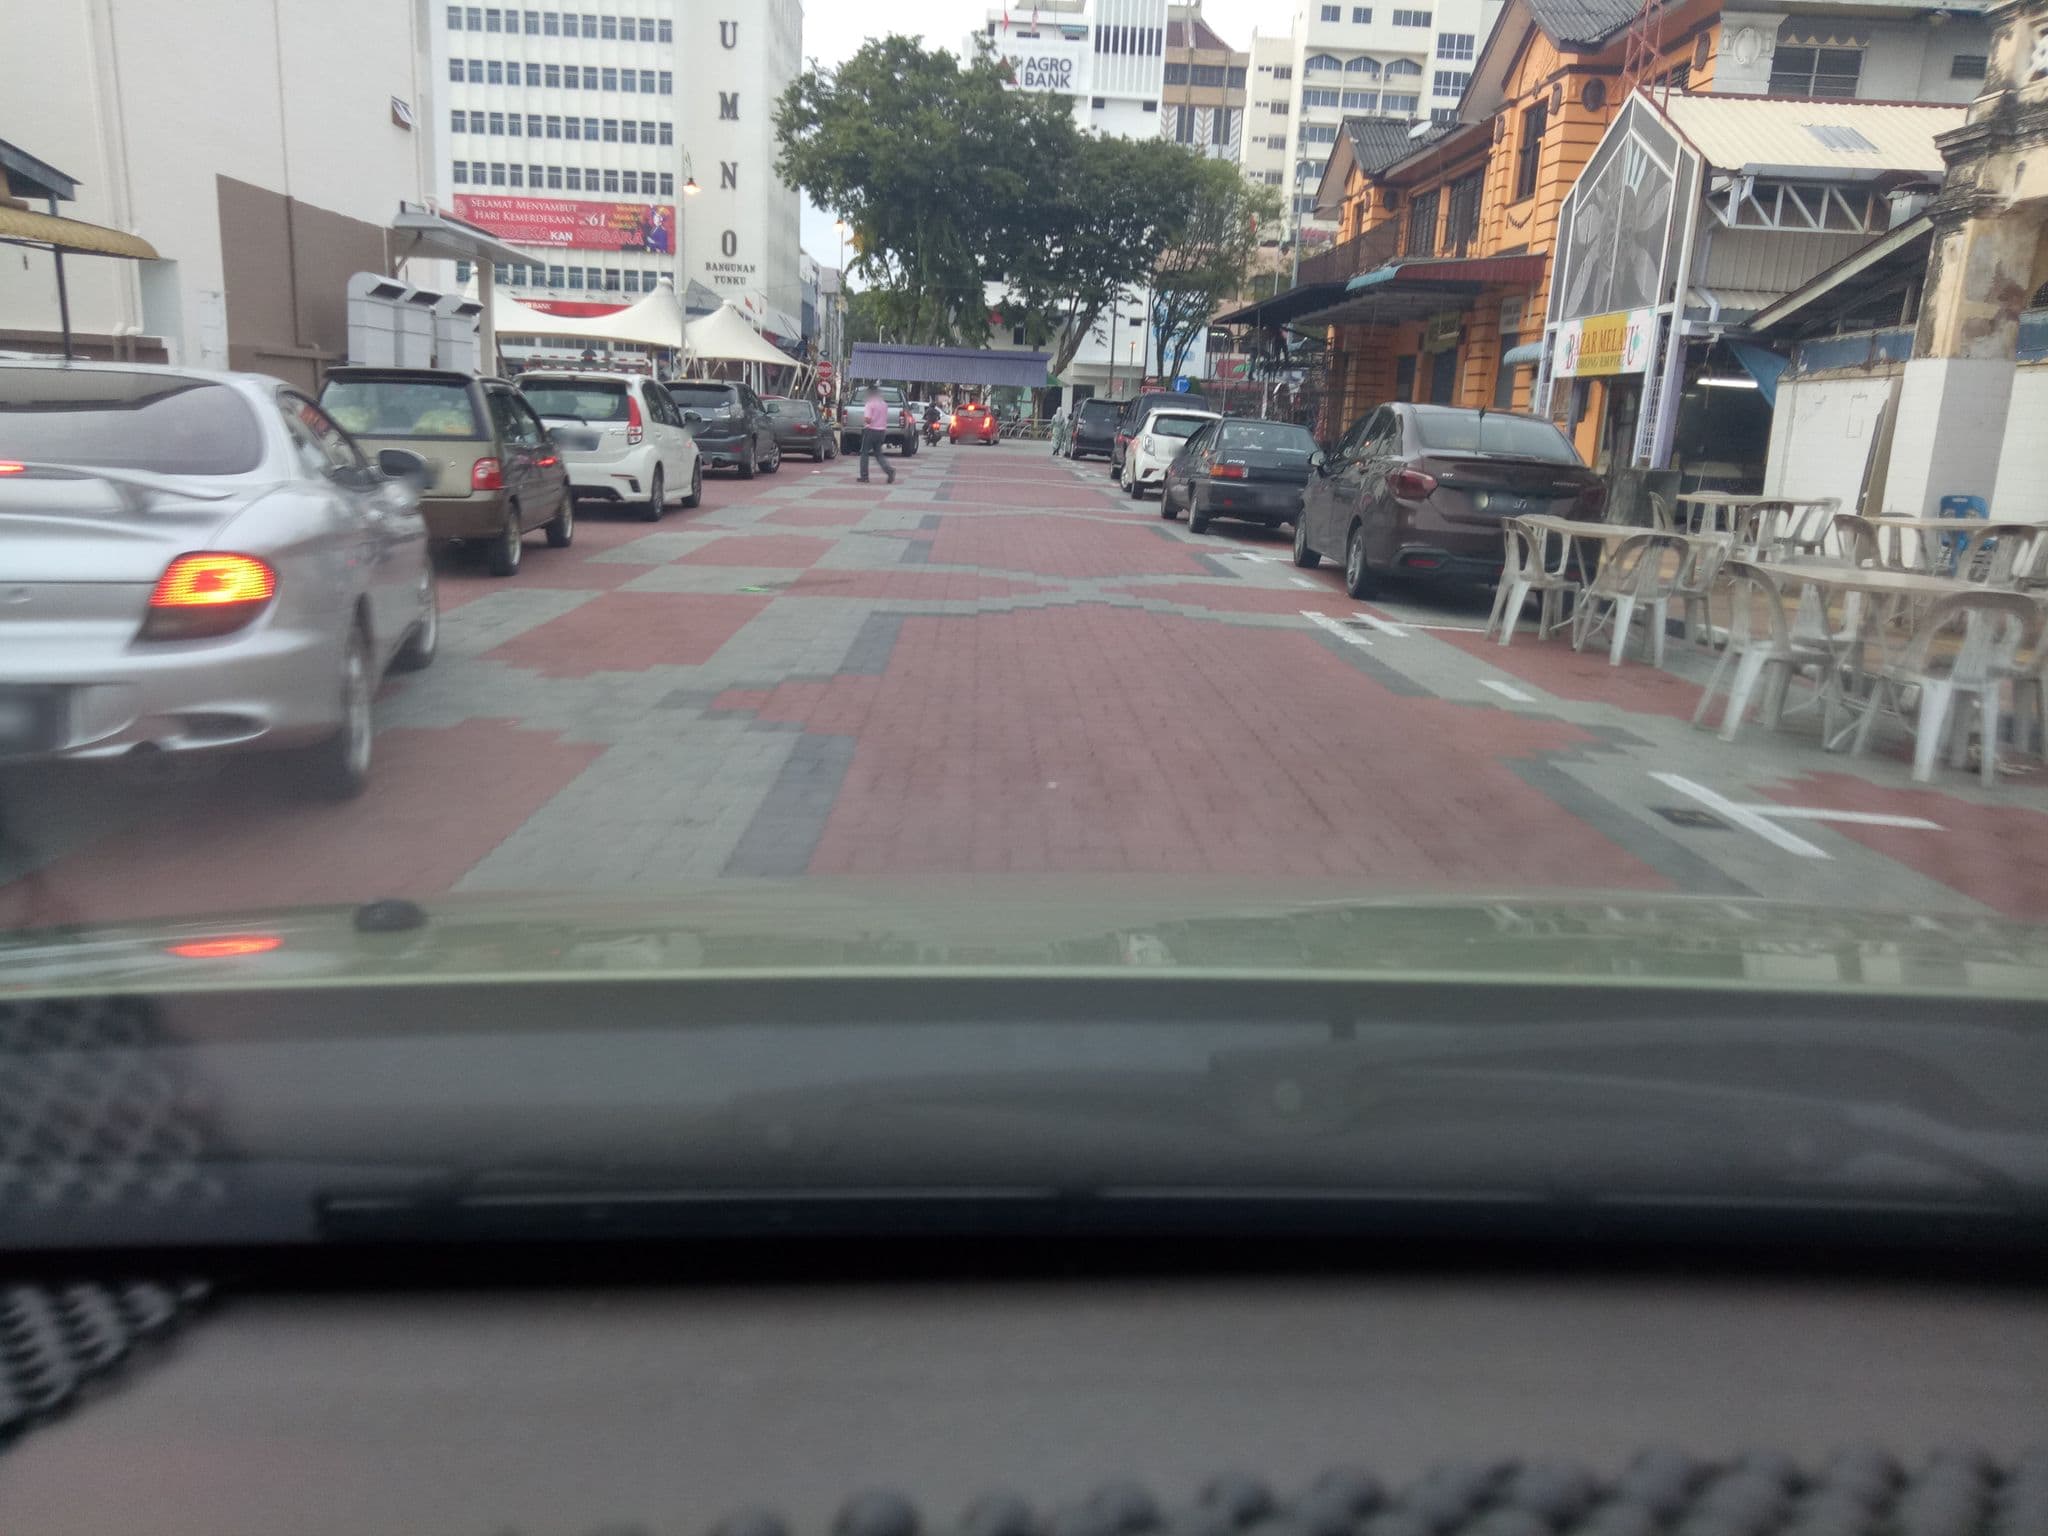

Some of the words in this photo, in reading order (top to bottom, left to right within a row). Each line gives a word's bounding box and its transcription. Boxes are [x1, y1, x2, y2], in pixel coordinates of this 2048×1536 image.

[1025, 56, 1072, 72] AGRO
[1025, 72, 1071, 88] BANK
[719, 21, 739, 257] UMNO
[471, 199, 513, 209] SELAMAT
[516, 201, 577, 212] MENYAMBUT
[475, 210, 500, 220] HARI
[503, 211, 575, 224] KEMERDEKAAN
[705, 262, 756, 273] BANGUNAN
[1566, 330, 1598, 369] BAZAR
[1599, 324, 1640, 366] MELAYU
